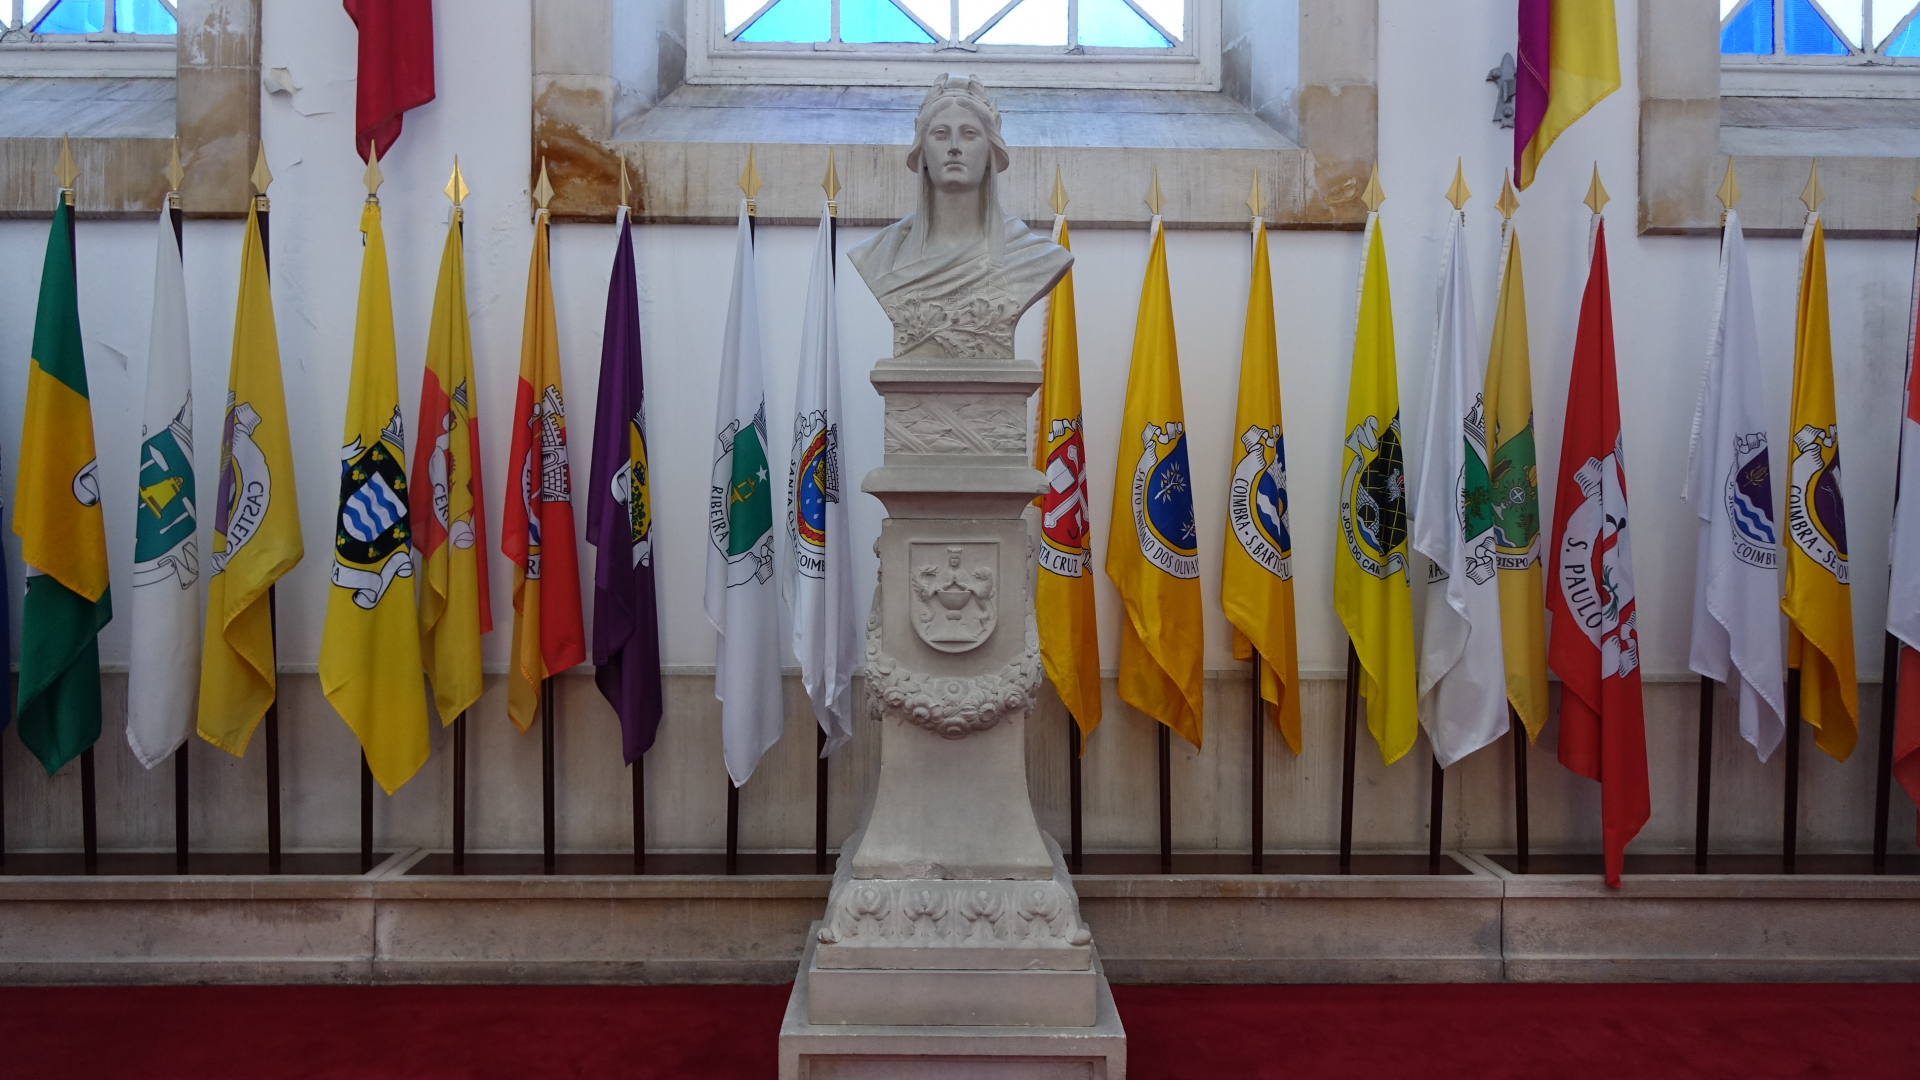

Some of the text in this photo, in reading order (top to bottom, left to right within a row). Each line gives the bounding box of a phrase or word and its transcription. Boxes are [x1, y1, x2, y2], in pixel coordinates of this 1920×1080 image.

[787, 459, 796, 507] SANTA
[711, 485, 730, 543] RIBEIRA
[1134, 468, 1146, 505] SANTO
[1152, 547, 1174, 569] DOS
[1232, 478, 1250, 531] COIMBRA
[1245, 535, 1259, 549] S.
[1341, 502, 1350, 513] S.
[1351, 545, 1362, 561] DO
[1789, 484, 1818, 549] COIMBRA
[1039, 542, 1078, 574] TA CRUZ
[1496, 556, 1529, 568] BISPO
[1564, 537, 1603, 629] S. PAULO
